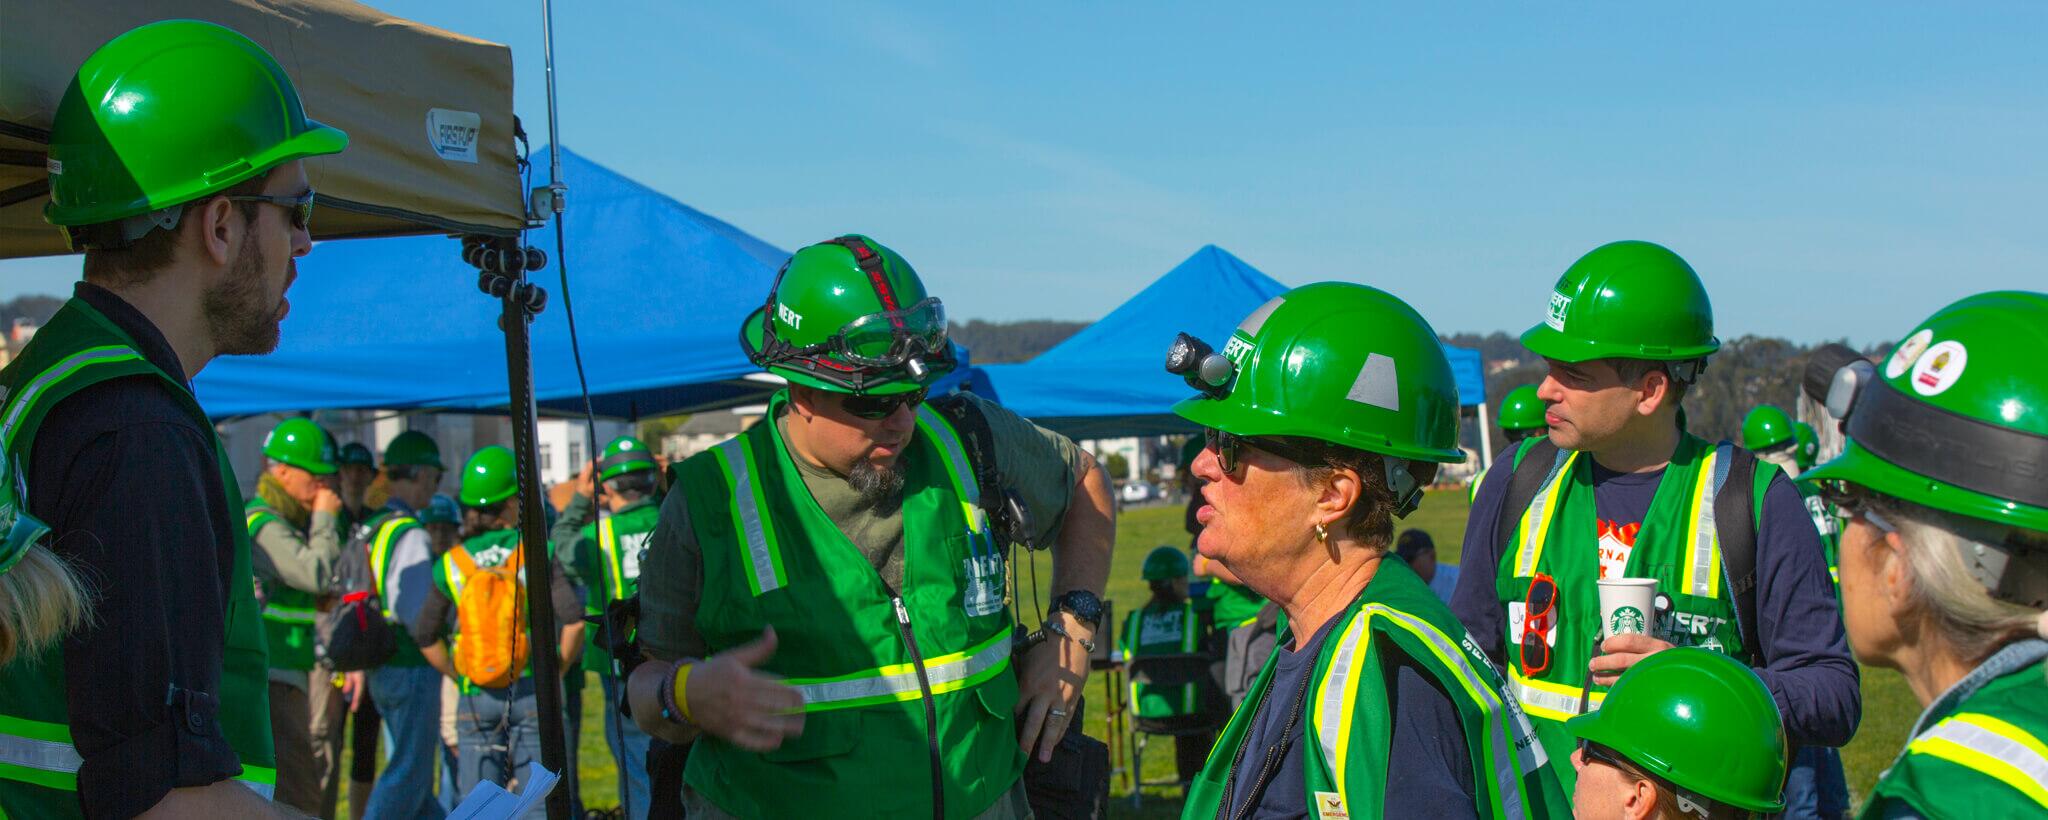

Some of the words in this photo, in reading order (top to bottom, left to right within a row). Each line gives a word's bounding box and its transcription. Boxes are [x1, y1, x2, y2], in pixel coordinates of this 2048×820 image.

[778, 302, 803, 331] NERT
[1552, 290, 1572, 314] ERT
[1224, 335, 1254, 365] ERT
